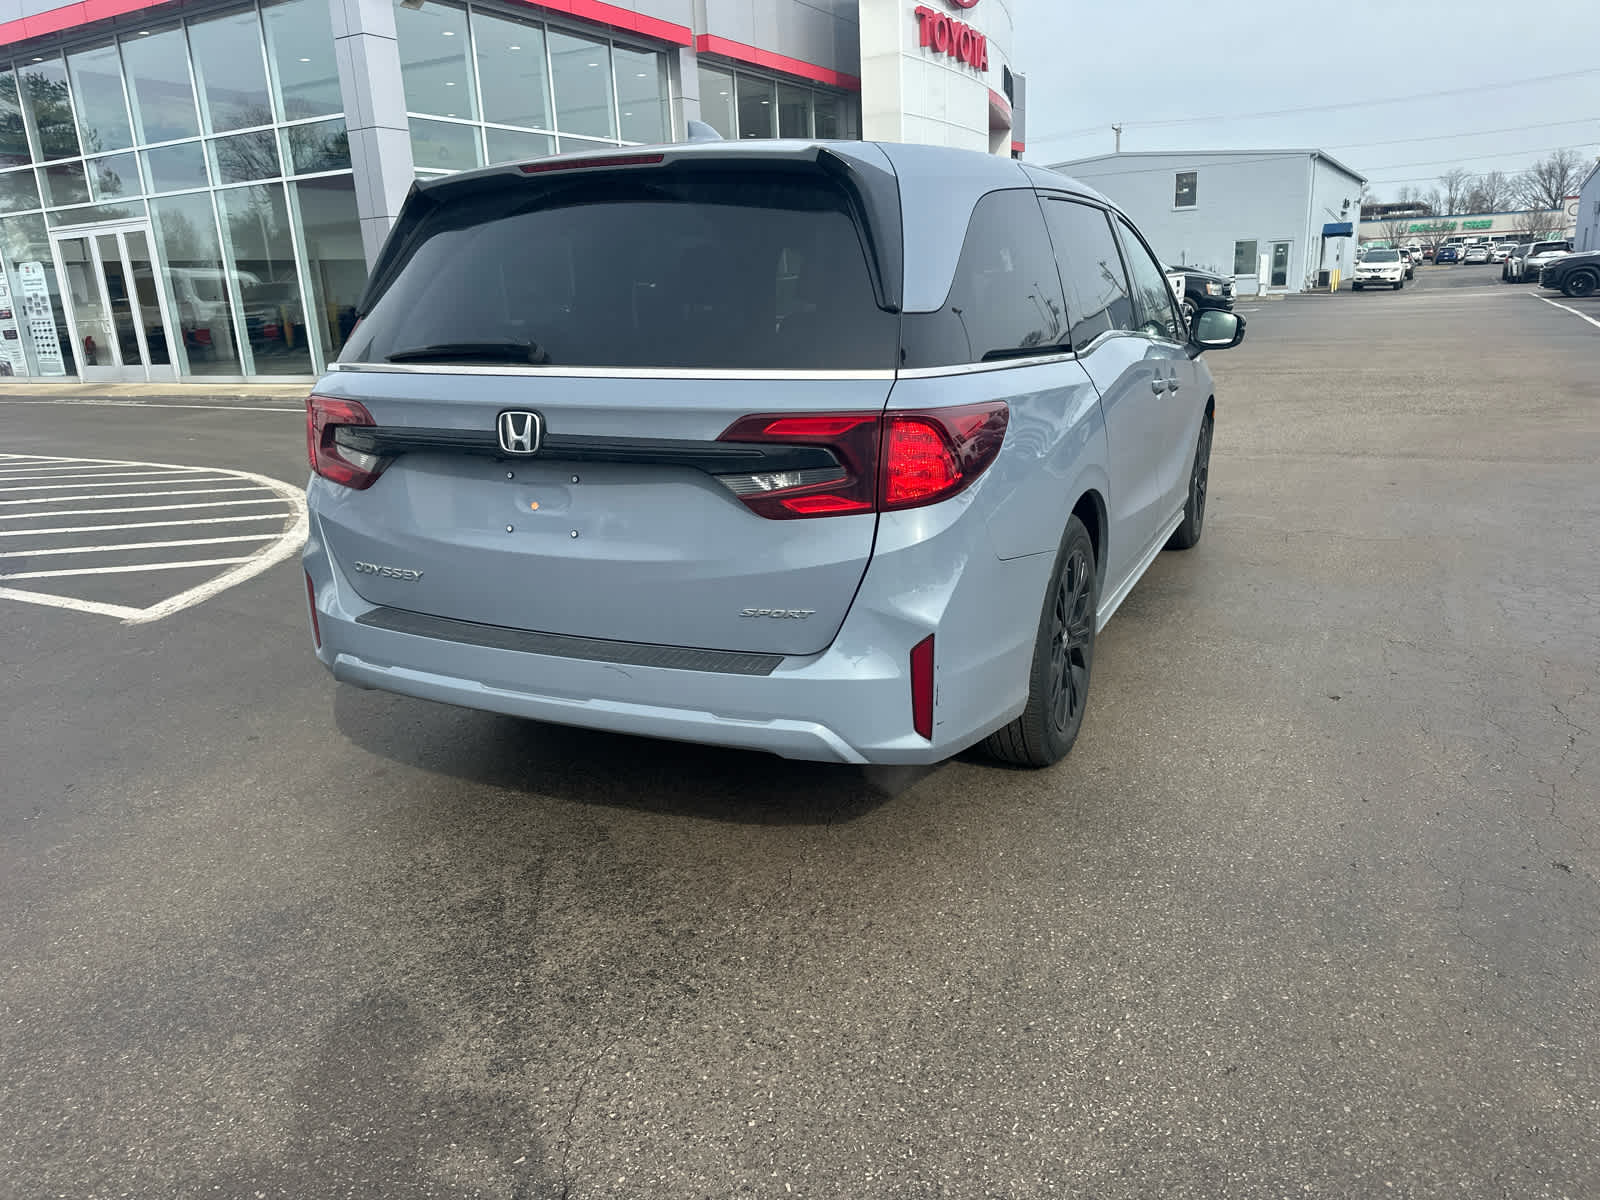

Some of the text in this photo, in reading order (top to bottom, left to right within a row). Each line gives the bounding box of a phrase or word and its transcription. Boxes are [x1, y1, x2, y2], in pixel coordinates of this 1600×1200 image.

[915, 5, 989, 72] TOYOTA
[354, 561, 424, 582] ODYSSEY
[739, 608, 817, 619] SPORT
